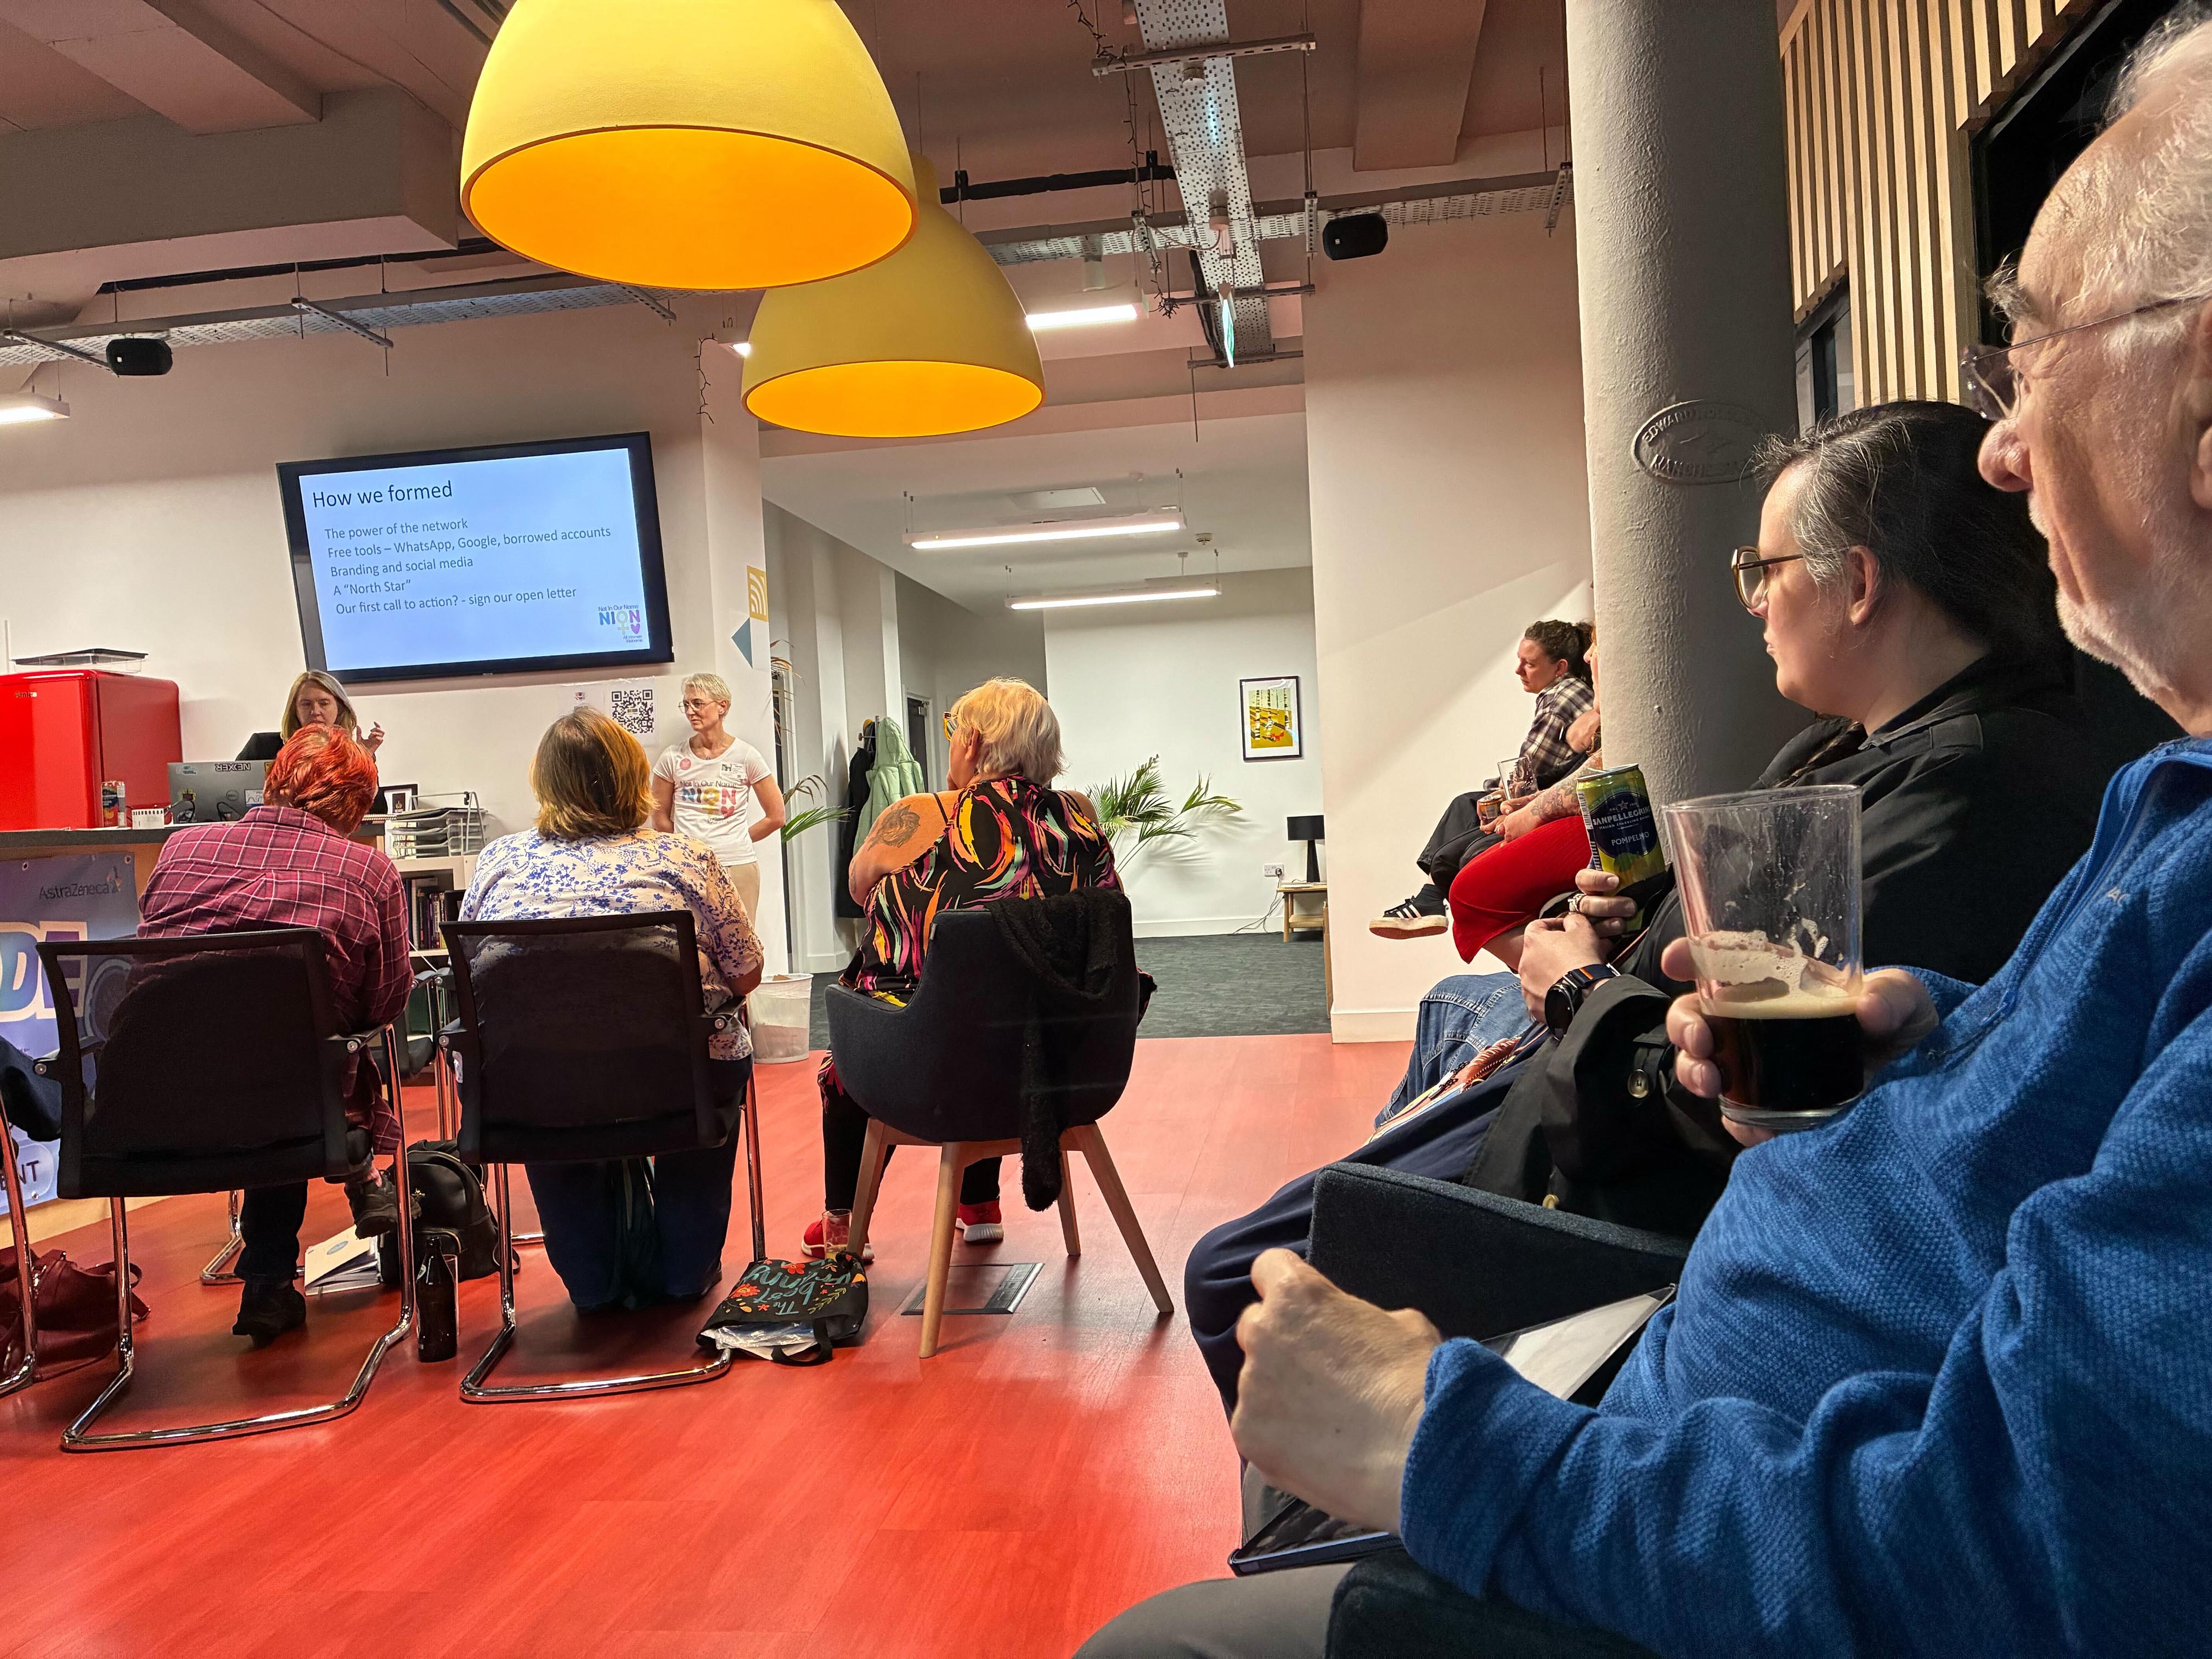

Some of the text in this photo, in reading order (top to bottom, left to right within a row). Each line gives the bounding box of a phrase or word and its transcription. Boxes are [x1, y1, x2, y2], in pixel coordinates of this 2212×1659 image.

[313, 480, 452, 507] How we formed
[325, 518, 468, 540] The power of the network
[328, 548, 352, 558] Free
[355, 544, 382, 556] tools
[393, 540, 455, 553] WhatsApp,
[458, 535, 500, 549] Google,
[504, 530, 557, 544] borrowed
[561, 527, 611, 540] accounts
[330, 556, 473, 577] Branding and social media
[334, 585, 341, 596] A
[336, 603, 356, 614] Our
[359, 601, 381, 613] first
[383, 599, 401, 611] call
[404, 600, 416, 610] to
[419, 595, 458, 608] action?
[469, 594, 490, 606] sign
[494, 593, 512, 603] our
[516, 590, 544, 603] open
[546, 588, 577, 599] letter
[1611, 832, 1649, 845] POMPELMO
[39, 883, 109, 900] AstraZeneca
